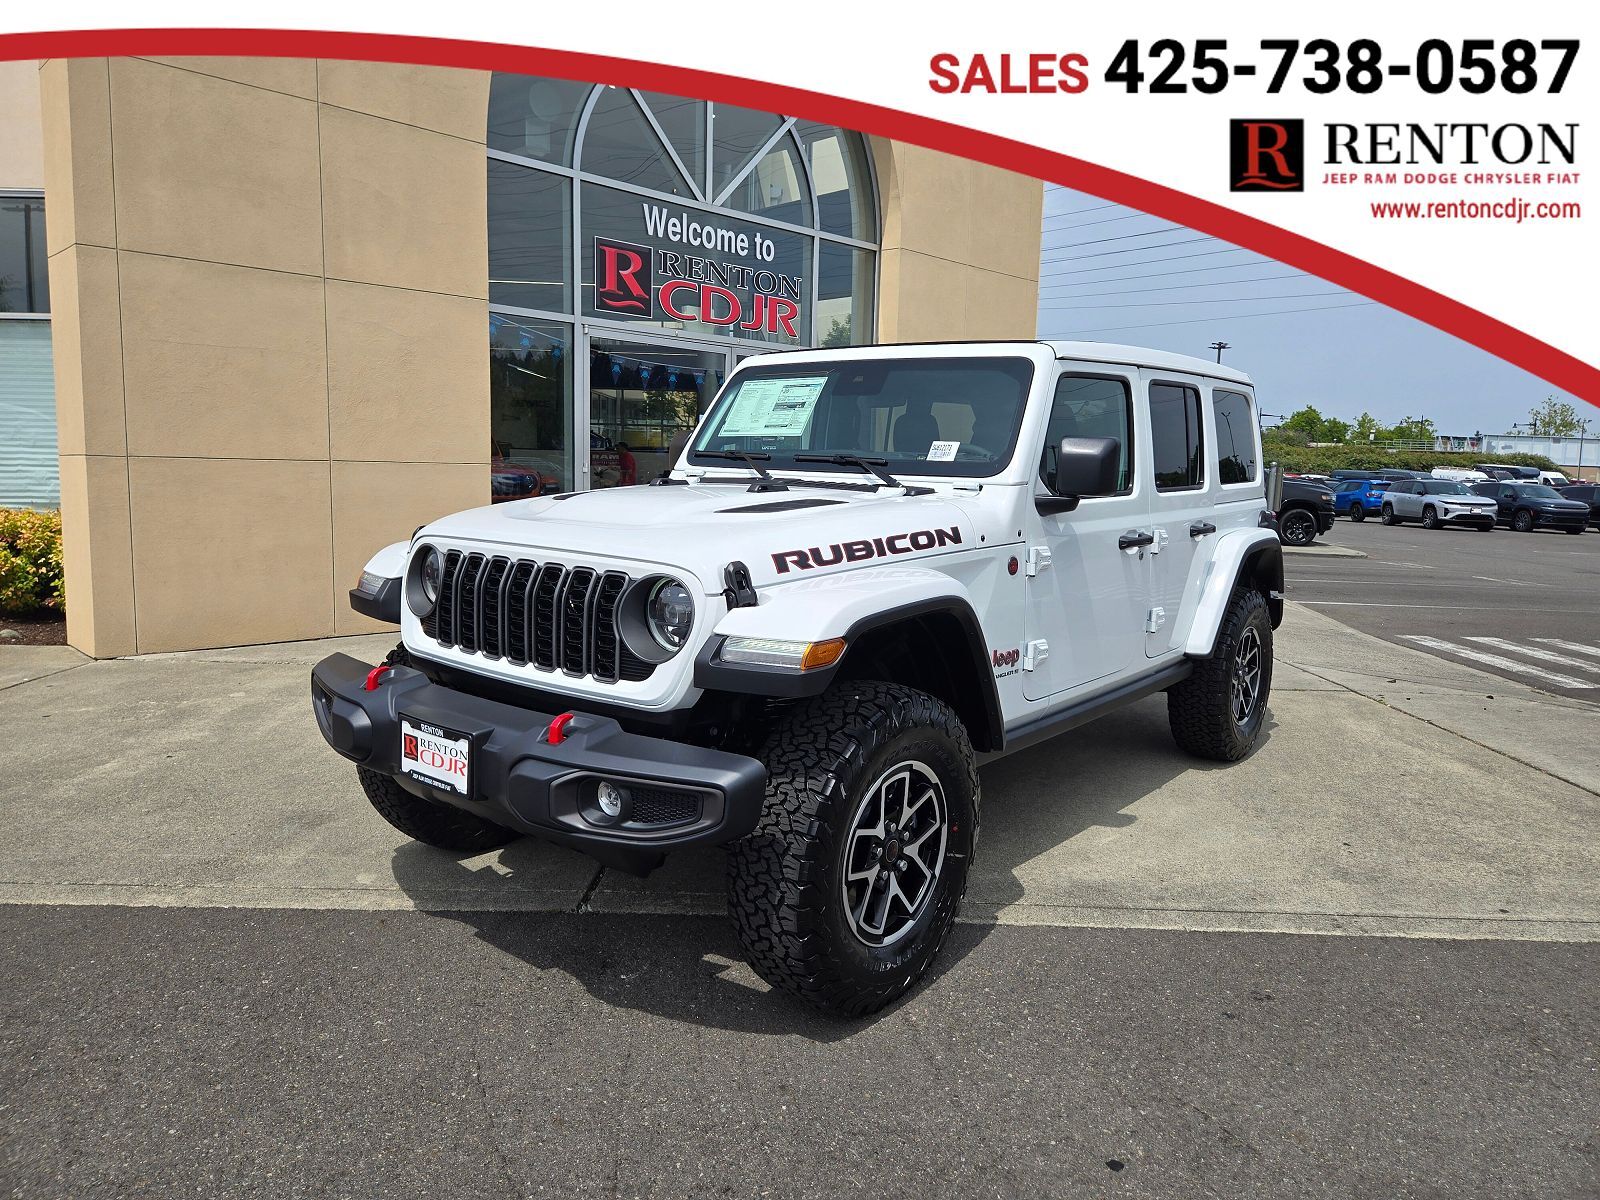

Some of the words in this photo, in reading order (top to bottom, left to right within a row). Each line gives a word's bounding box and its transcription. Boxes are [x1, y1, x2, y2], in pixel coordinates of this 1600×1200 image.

[642, 203, 749, 257] Welcome
[755, 232, 775, 262] to
[600, 246, 649, 299] R
[658, 250, 802, 299] RENTON
[658, 280, 799, 338] CDJR
[771, 526, 963, 574] RUBICON
[404, 735, 418, 757] R
[420, 723, 444, 738] RENTON
[420, 738, 468, 761] RENTON
[420, 749, 467, 777] CDJR
